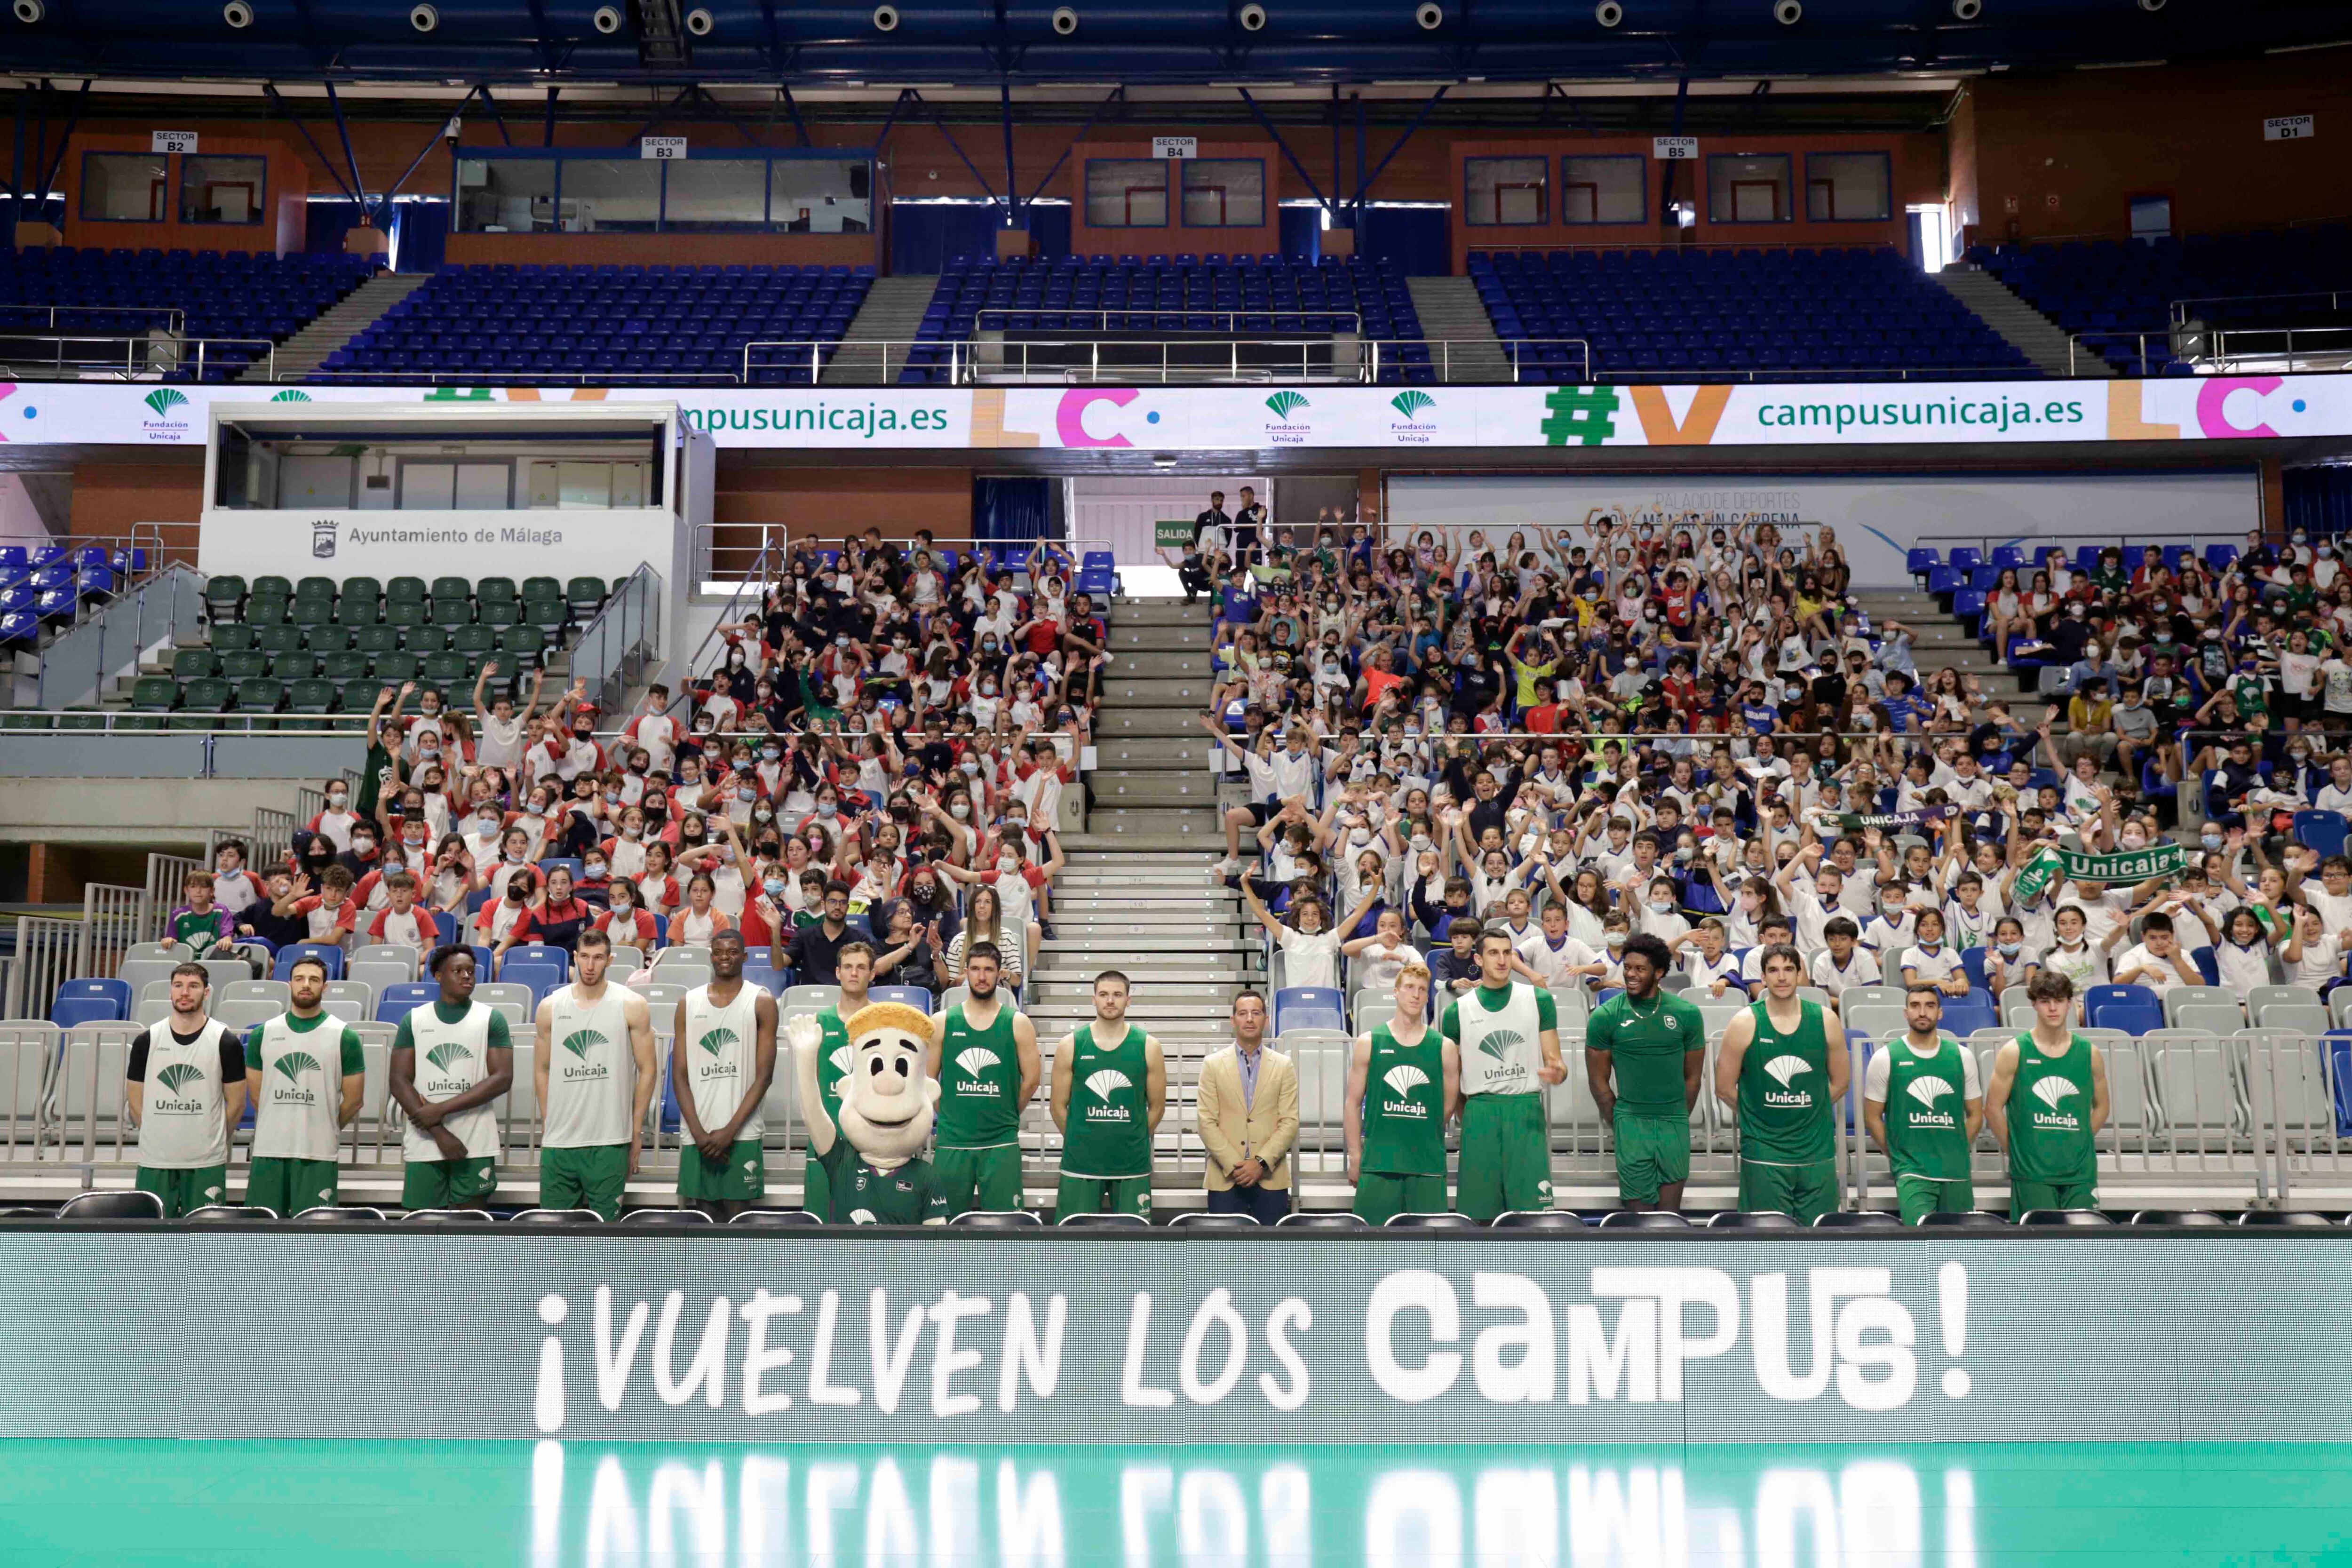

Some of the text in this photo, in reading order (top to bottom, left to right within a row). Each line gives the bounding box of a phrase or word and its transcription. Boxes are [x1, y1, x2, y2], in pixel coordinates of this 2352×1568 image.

[2268, 117, 2310, 127] SECTOR
[2281, 127, 2297, 137] D1
[167, 142, 183, 151] B2
[656, 148, 673, 157] B3
[1168, 147, 1183, 157] B4
[1669, 147, 1685, 157] B5
[1759, 396, 2083, 432] campusunicaja.es
[150, 431, 181, 441] Unicaja
[1272, 434, 1303, 444] Unicaja
[1398, 434, 1429, 443] Unicaja
[1655, 492, 1801, 509] PALACIO DE DEPORTES
[349, 526, 563, 545] Ayuntamiento de Málaga
[1157, 529, 1193, 539] SALIDA
[1859, 812, 1920, 825] UNICAJA
[2071, 851, 2169, 875] Unicaja
[564, 1063, 608, 1077] Unicaja
[701, 1062, 737, 1076] Unicaja
[1484, 1063, 1526, 1081] Unicaja
[428, 1078, 471, 1092] Unicaja
[957, 1080, 999, 1094] Unicaja
[275, 1089, 314, 1103] Unicaja
[1765, 1090, 1811, 1105] Unicaja
[156, 1099, 202, 1112] Unicaja
[1383, 1100, 1426, 1116] Unicaja
[1086, 1106, 1129, 1120] Unicaja
[1909, 1111, 1954, 1126] Unicaja
[2034, 1112, 2078, 1127] Unicaja
[535, 1284, 1067, 1433] ¡VUELVEN
[1121, 1287, 1312, 1410] LOS
